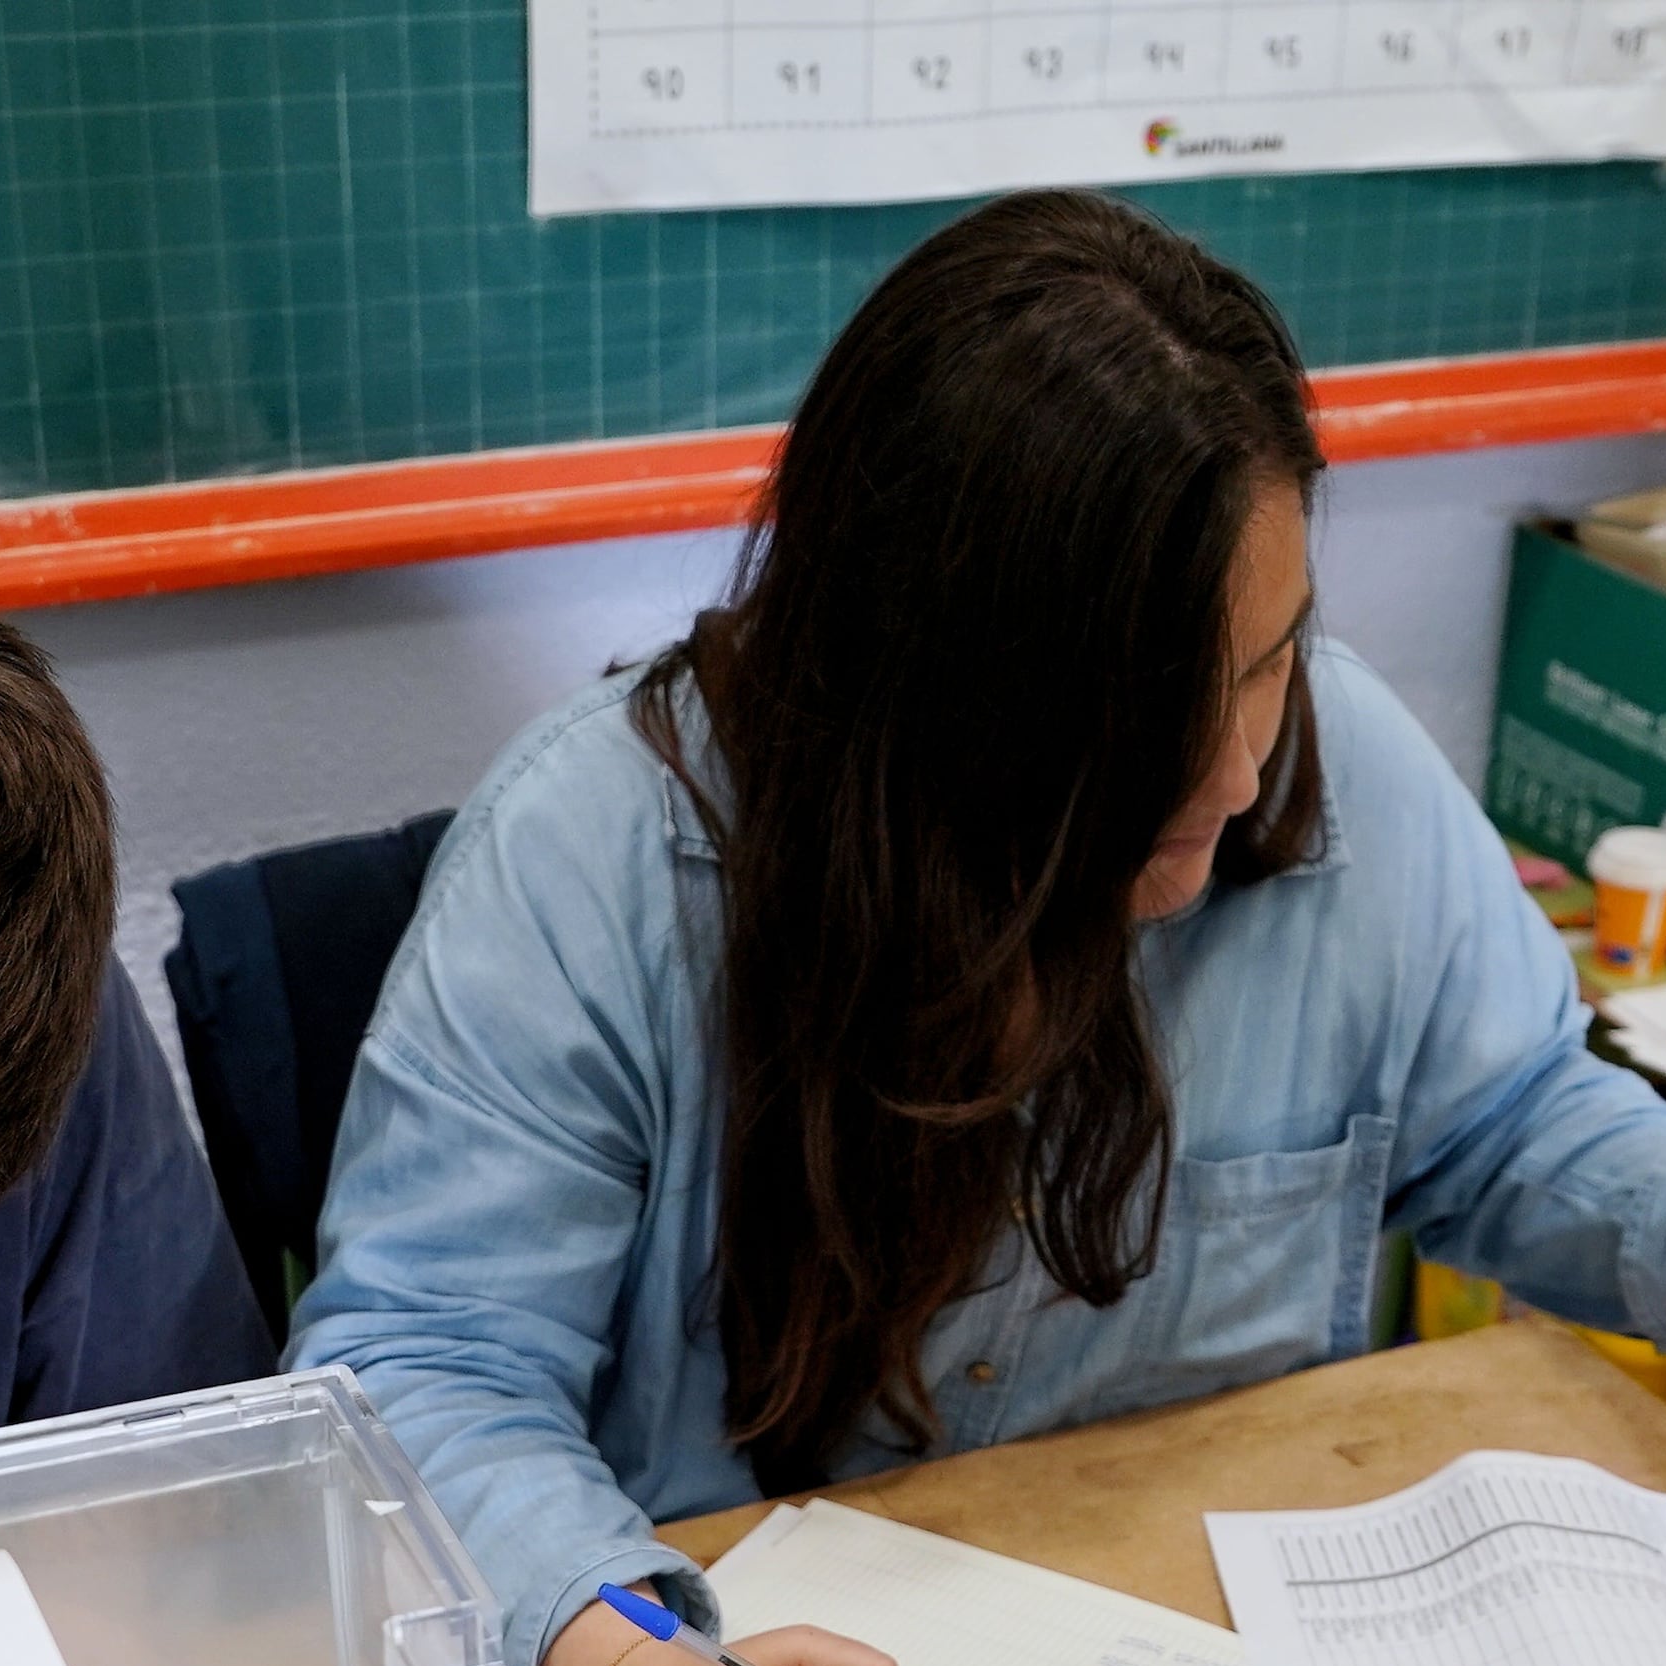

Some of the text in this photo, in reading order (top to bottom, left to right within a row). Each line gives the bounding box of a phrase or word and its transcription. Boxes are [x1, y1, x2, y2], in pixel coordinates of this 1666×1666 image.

[643, 66, 684, 99] 90
[776, 60, 820, 94] 91
[912, 55, 951, 90] 92
[1023, 46, 1063, 80] 93
[1145, 41, 1184, 73] 94
[1265, 36, 1300, 69] 95
[1380, 27, 1415, 64] 96
